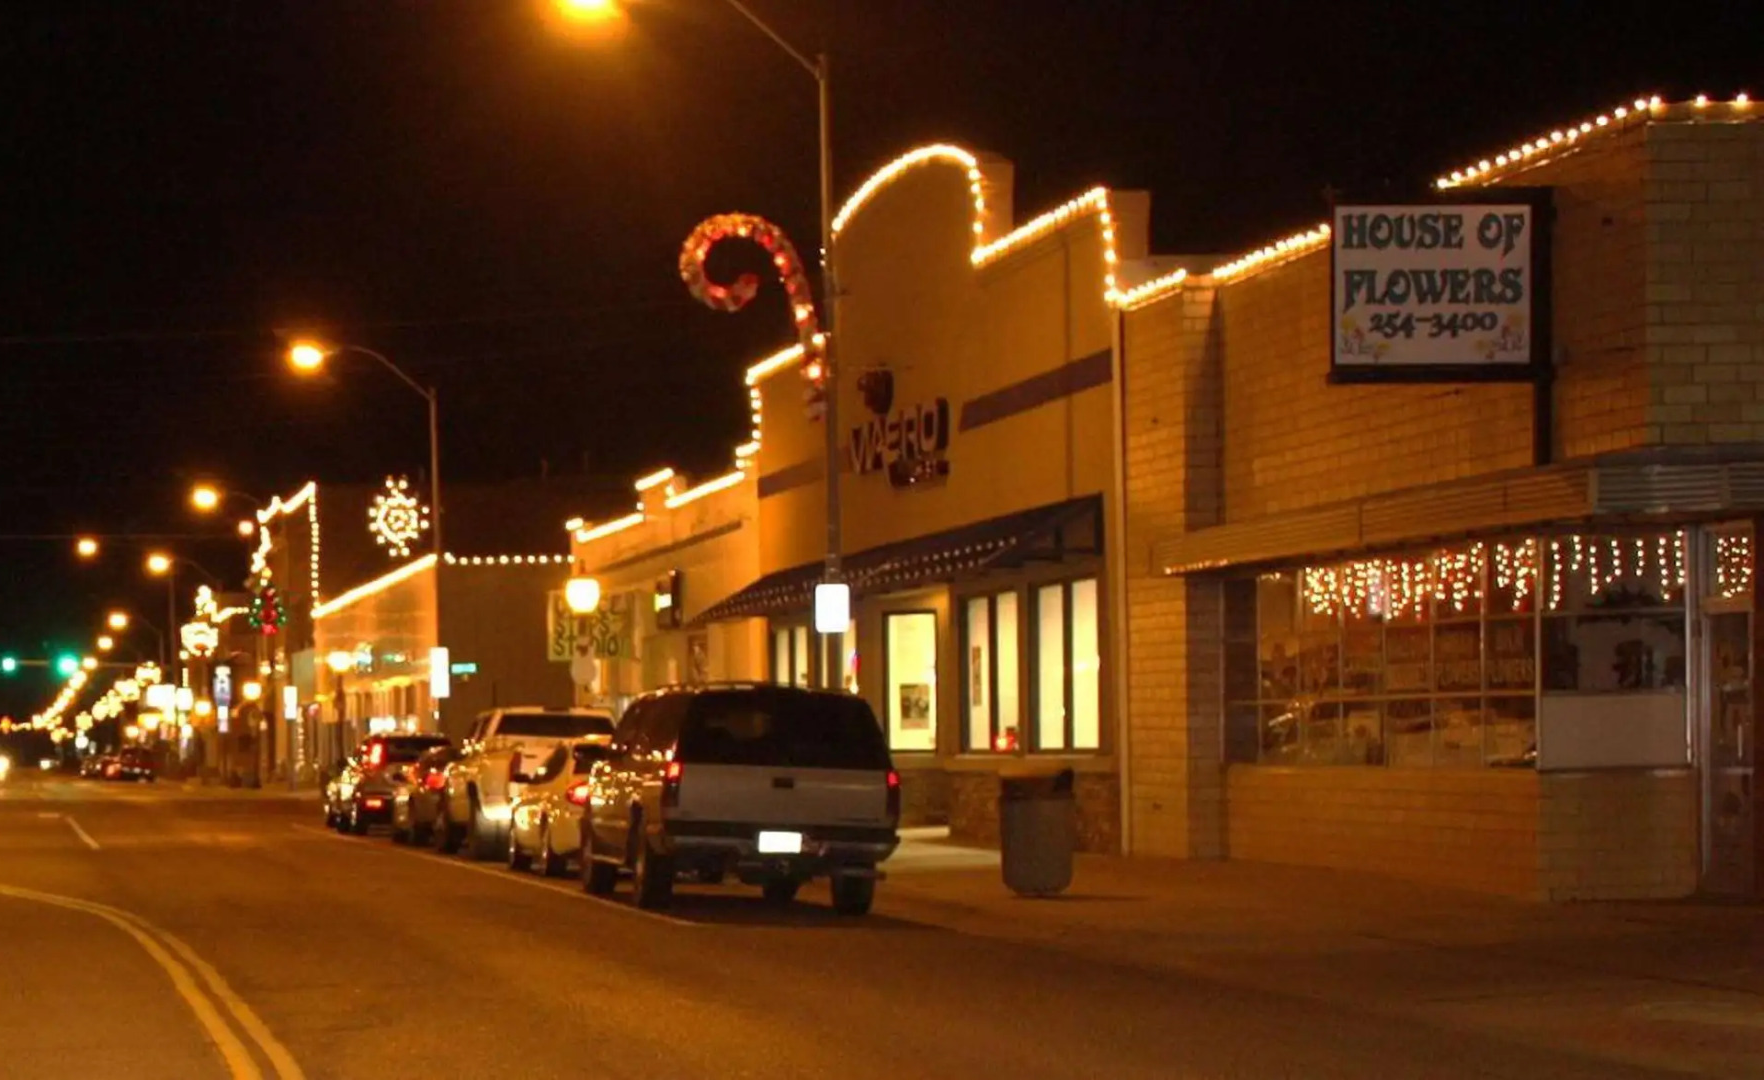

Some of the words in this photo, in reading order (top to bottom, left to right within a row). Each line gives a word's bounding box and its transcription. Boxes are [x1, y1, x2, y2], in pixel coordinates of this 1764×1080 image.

[1342, 212, 1465, 249] HOUSE
[1477, 212, 1525, 256] OF
[1343, 268, 1523, 313] FLOWERS
[1369, 310, 1498, 338] 254-3400
